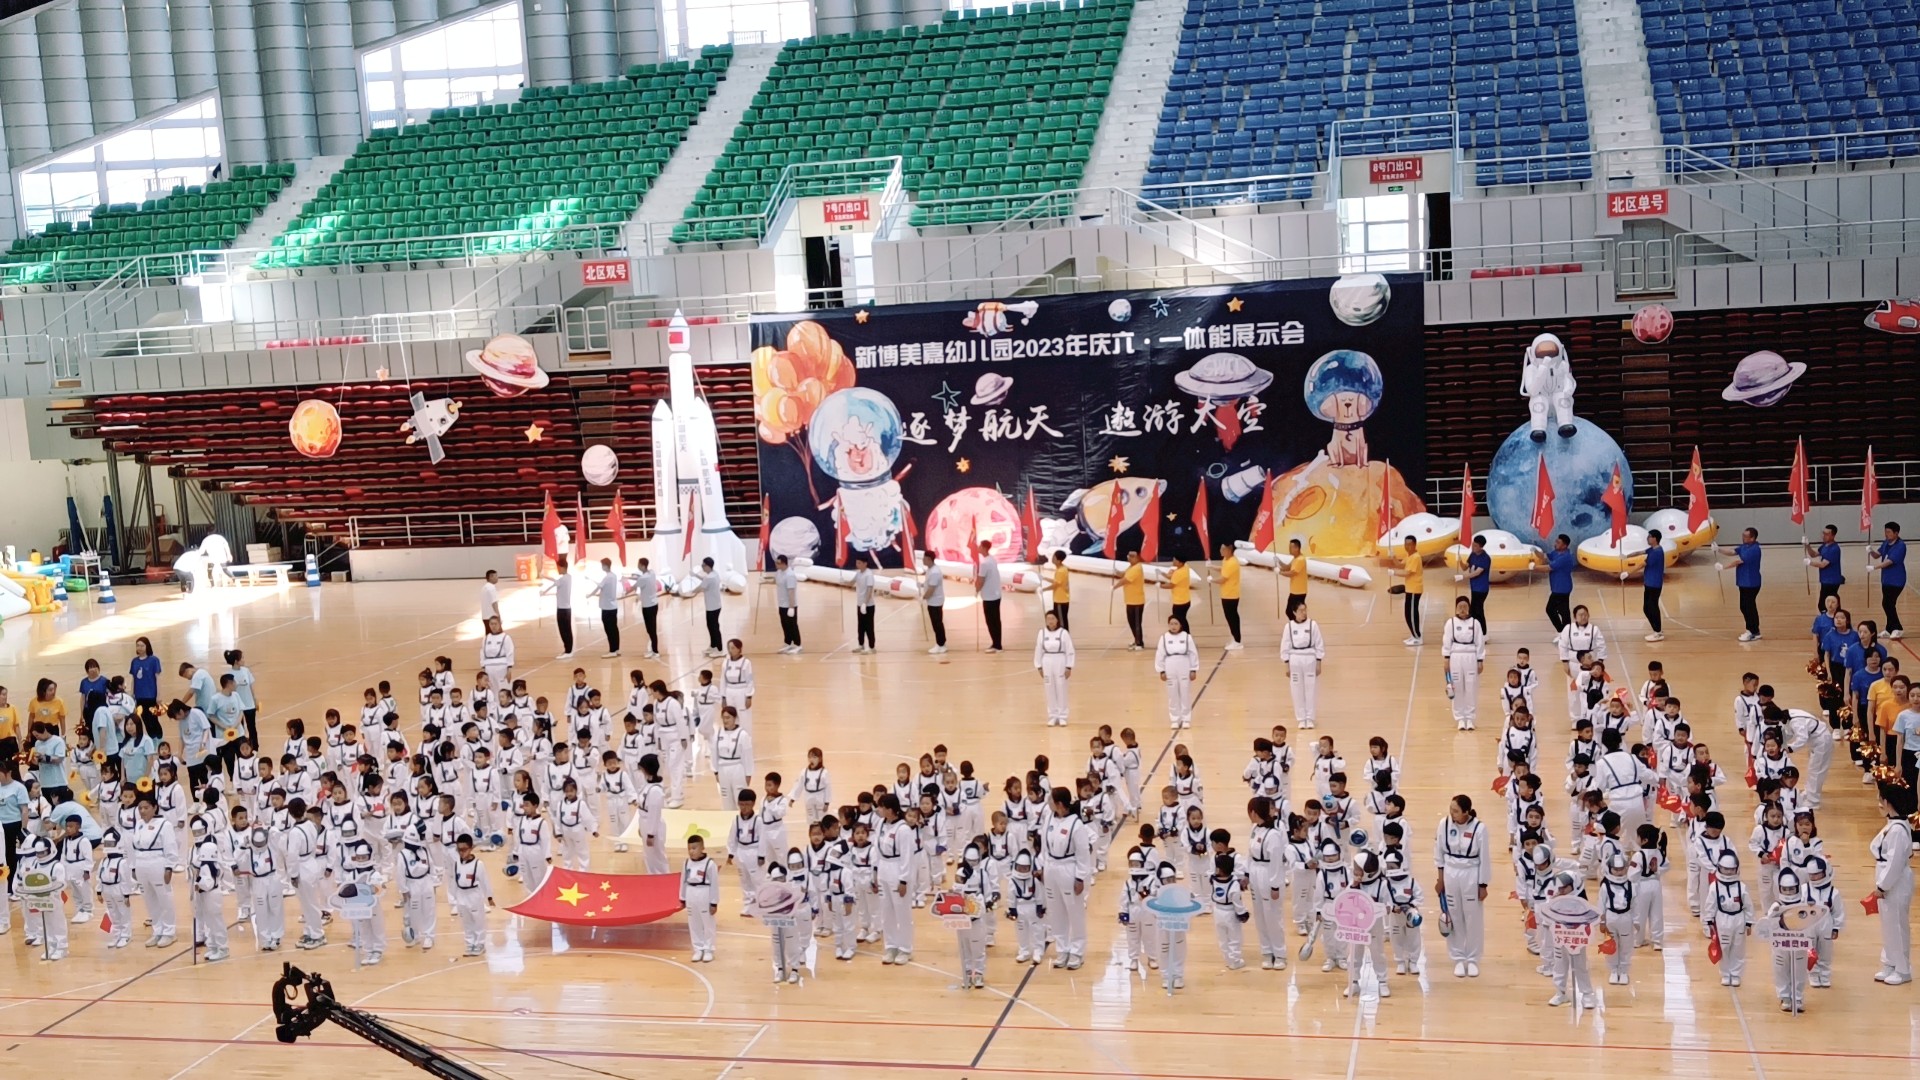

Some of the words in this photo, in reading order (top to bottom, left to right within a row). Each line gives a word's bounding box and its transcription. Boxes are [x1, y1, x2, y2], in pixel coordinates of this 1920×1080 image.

[1611, 194, 1664, 213] 北区单号
[585, 263, 627, 281] 北区双号
[896, 404, 1064, 454] 逐梦航天
[1098, 395, 1268, 438] 遨游太空
